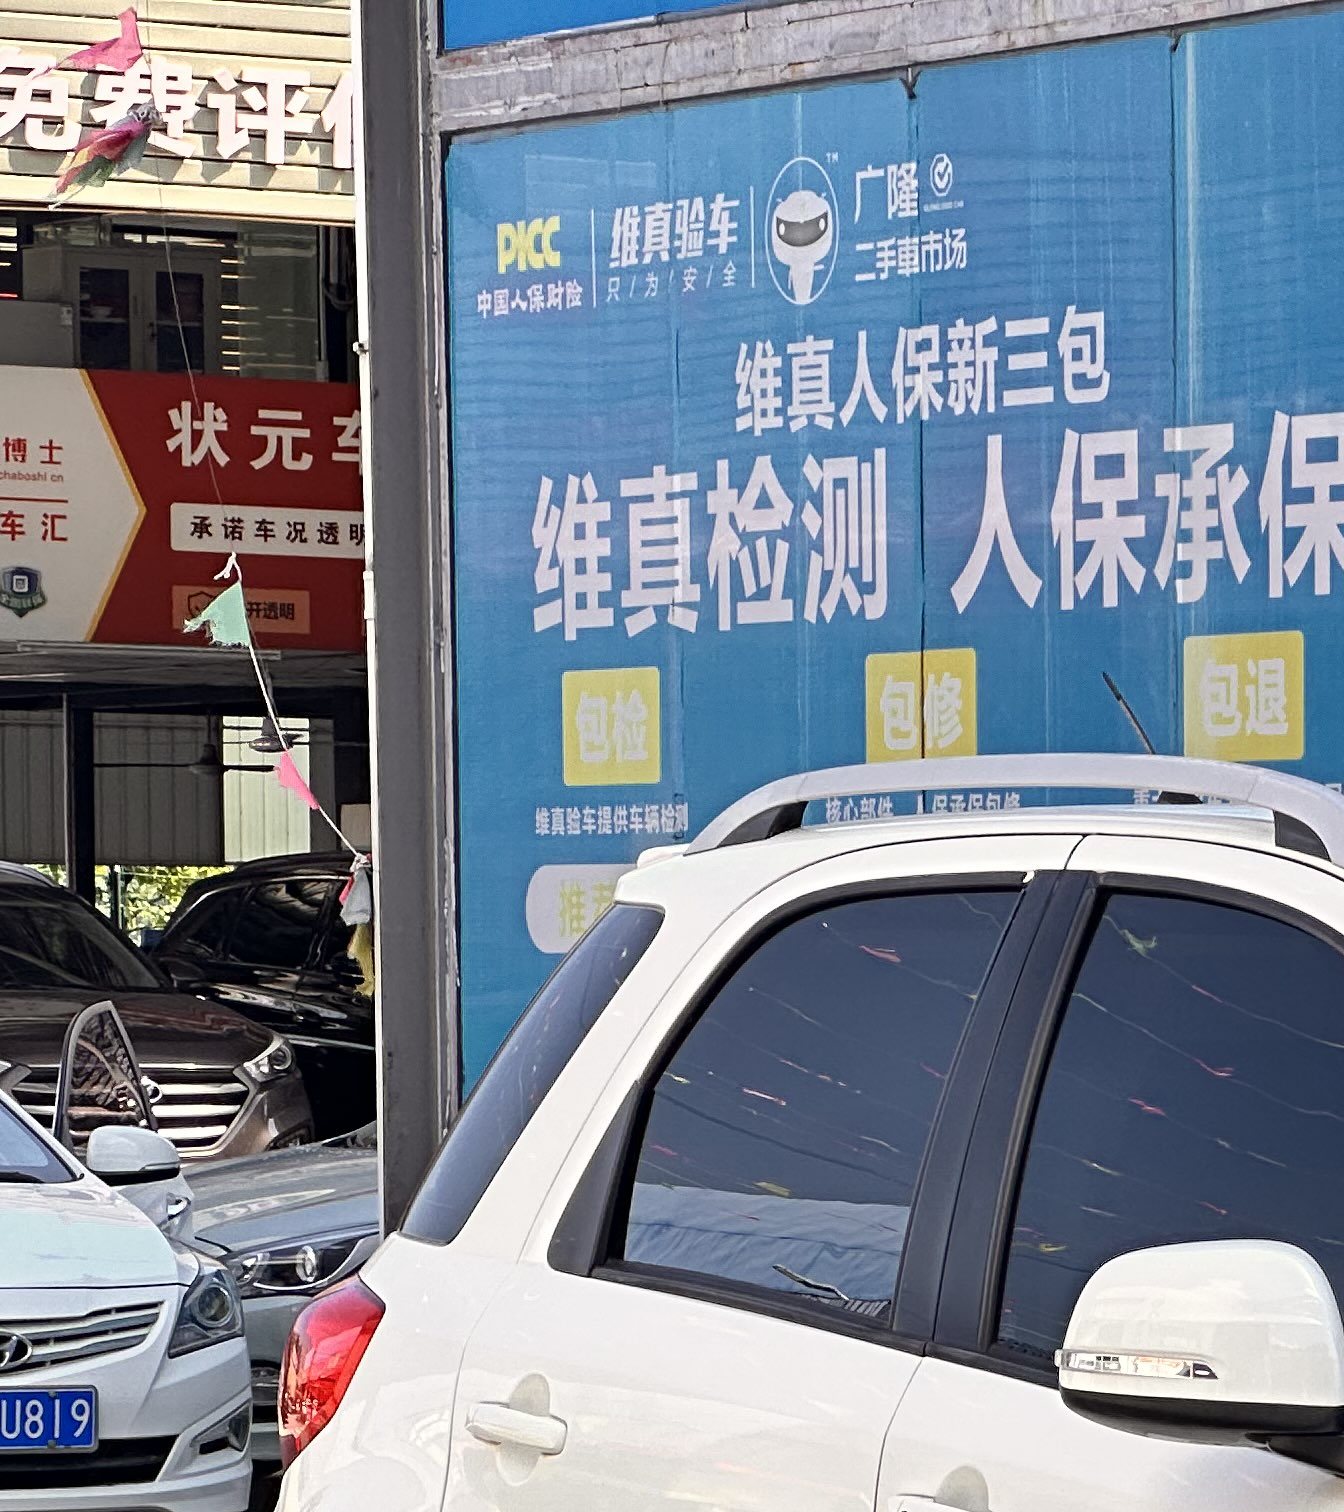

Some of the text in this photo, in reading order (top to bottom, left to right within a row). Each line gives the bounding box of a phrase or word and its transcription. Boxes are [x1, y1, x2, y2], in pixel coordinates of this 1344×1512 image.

[0, 46, 354, 168] 免费评
[854, 160, 918, 224] 广隆
[497, 216, 560, 274] PICC
[608, 193, 740, 268] 维真验车
[855, 228, 967, 282] 二手車市场
[477, 279, 584, 319] 中国人保财险
[735, 305, 1111, 436] 维真人保新三包
[3, 436, 64, 465] 博士
[190, 515, 365, 546] 承诺车况透明
[531, 447, 888, 641] 维真检测
[575, 690, 649, 764] 包检
[880, 673, 963, 751] 包修
[1203, 657, 1288, 738] 包退
[535, 802, 688, 836] 维真验车提供车辆检测
